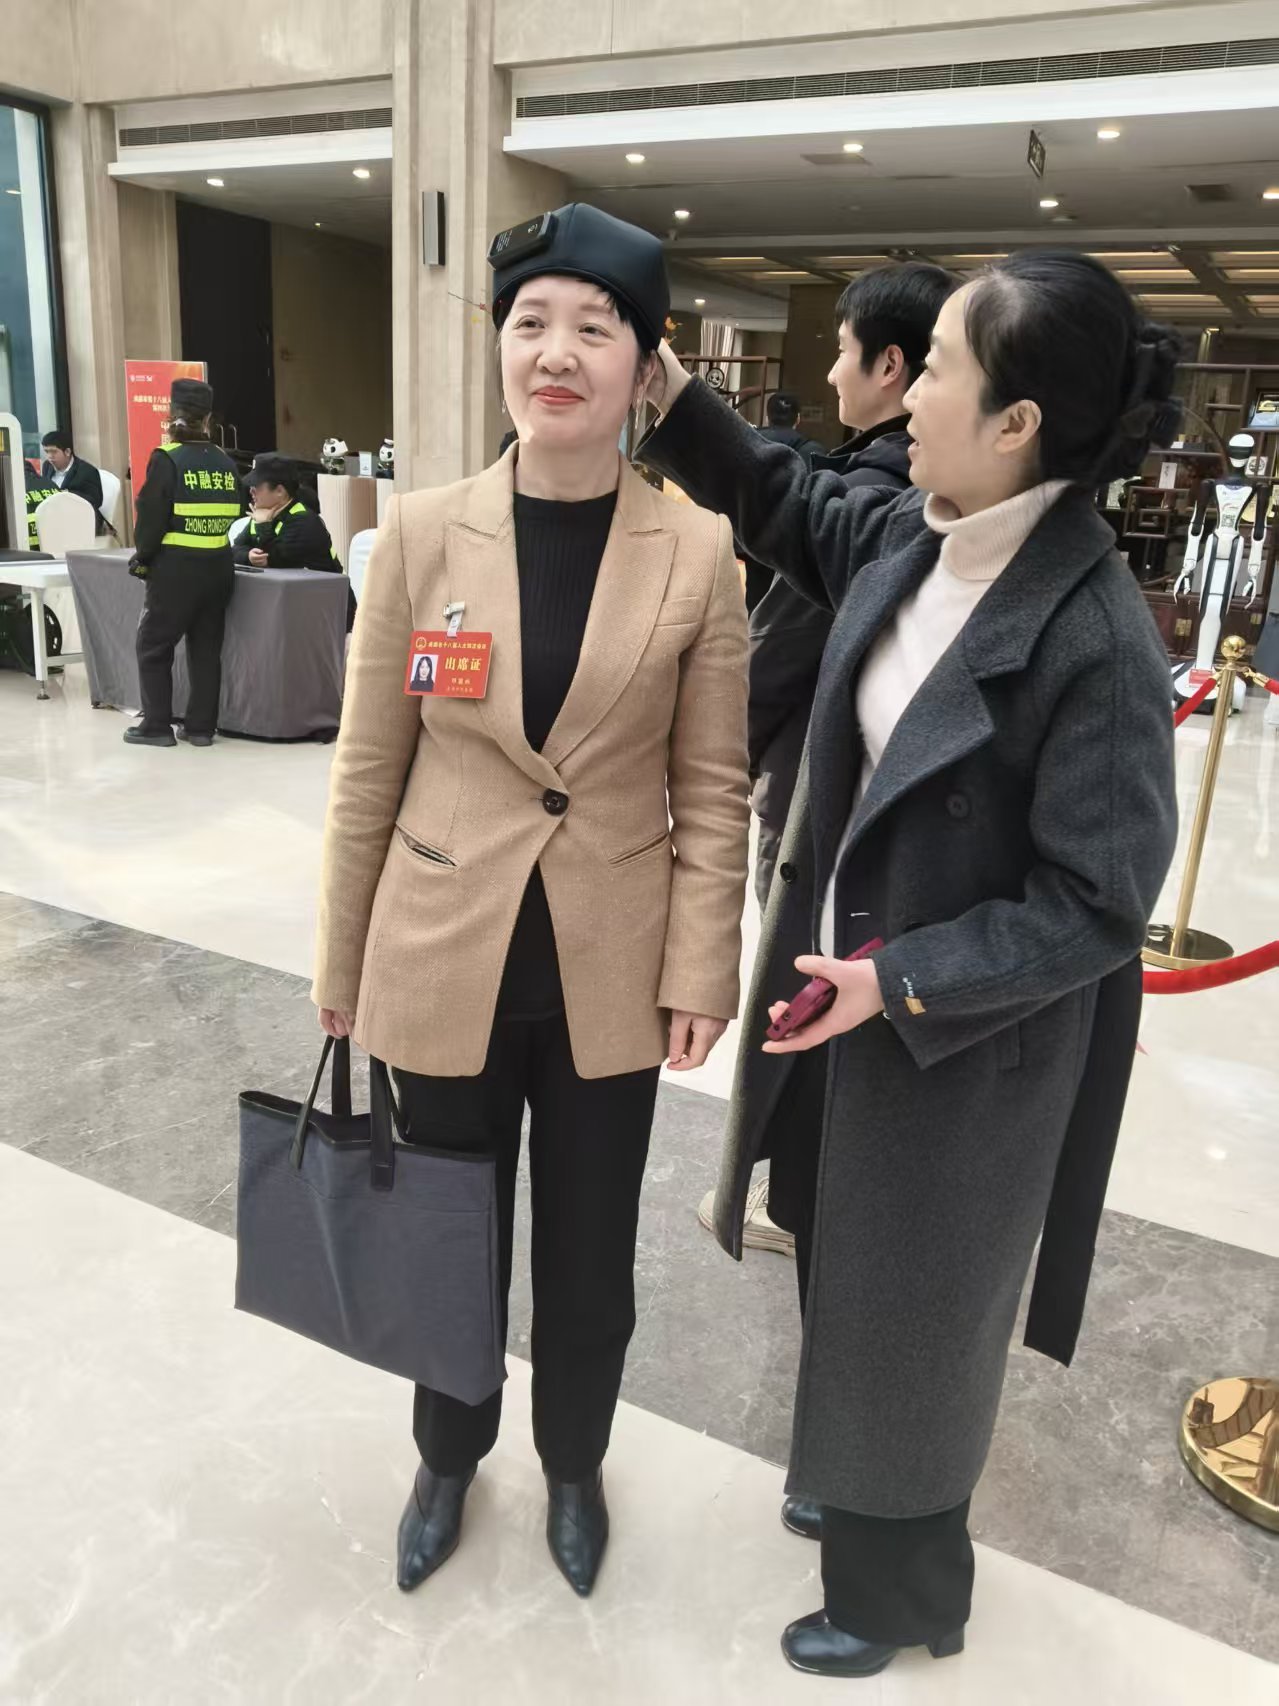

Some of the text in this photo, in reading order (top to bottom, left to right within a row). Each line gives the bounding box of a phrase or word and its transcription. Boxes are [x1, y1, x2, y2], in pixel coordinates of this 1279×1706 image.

[184, 469, 235, 491] 中融安检
[184, 518, 207, 534] ZHONG
[445, 656, 482, 671] 出席证
